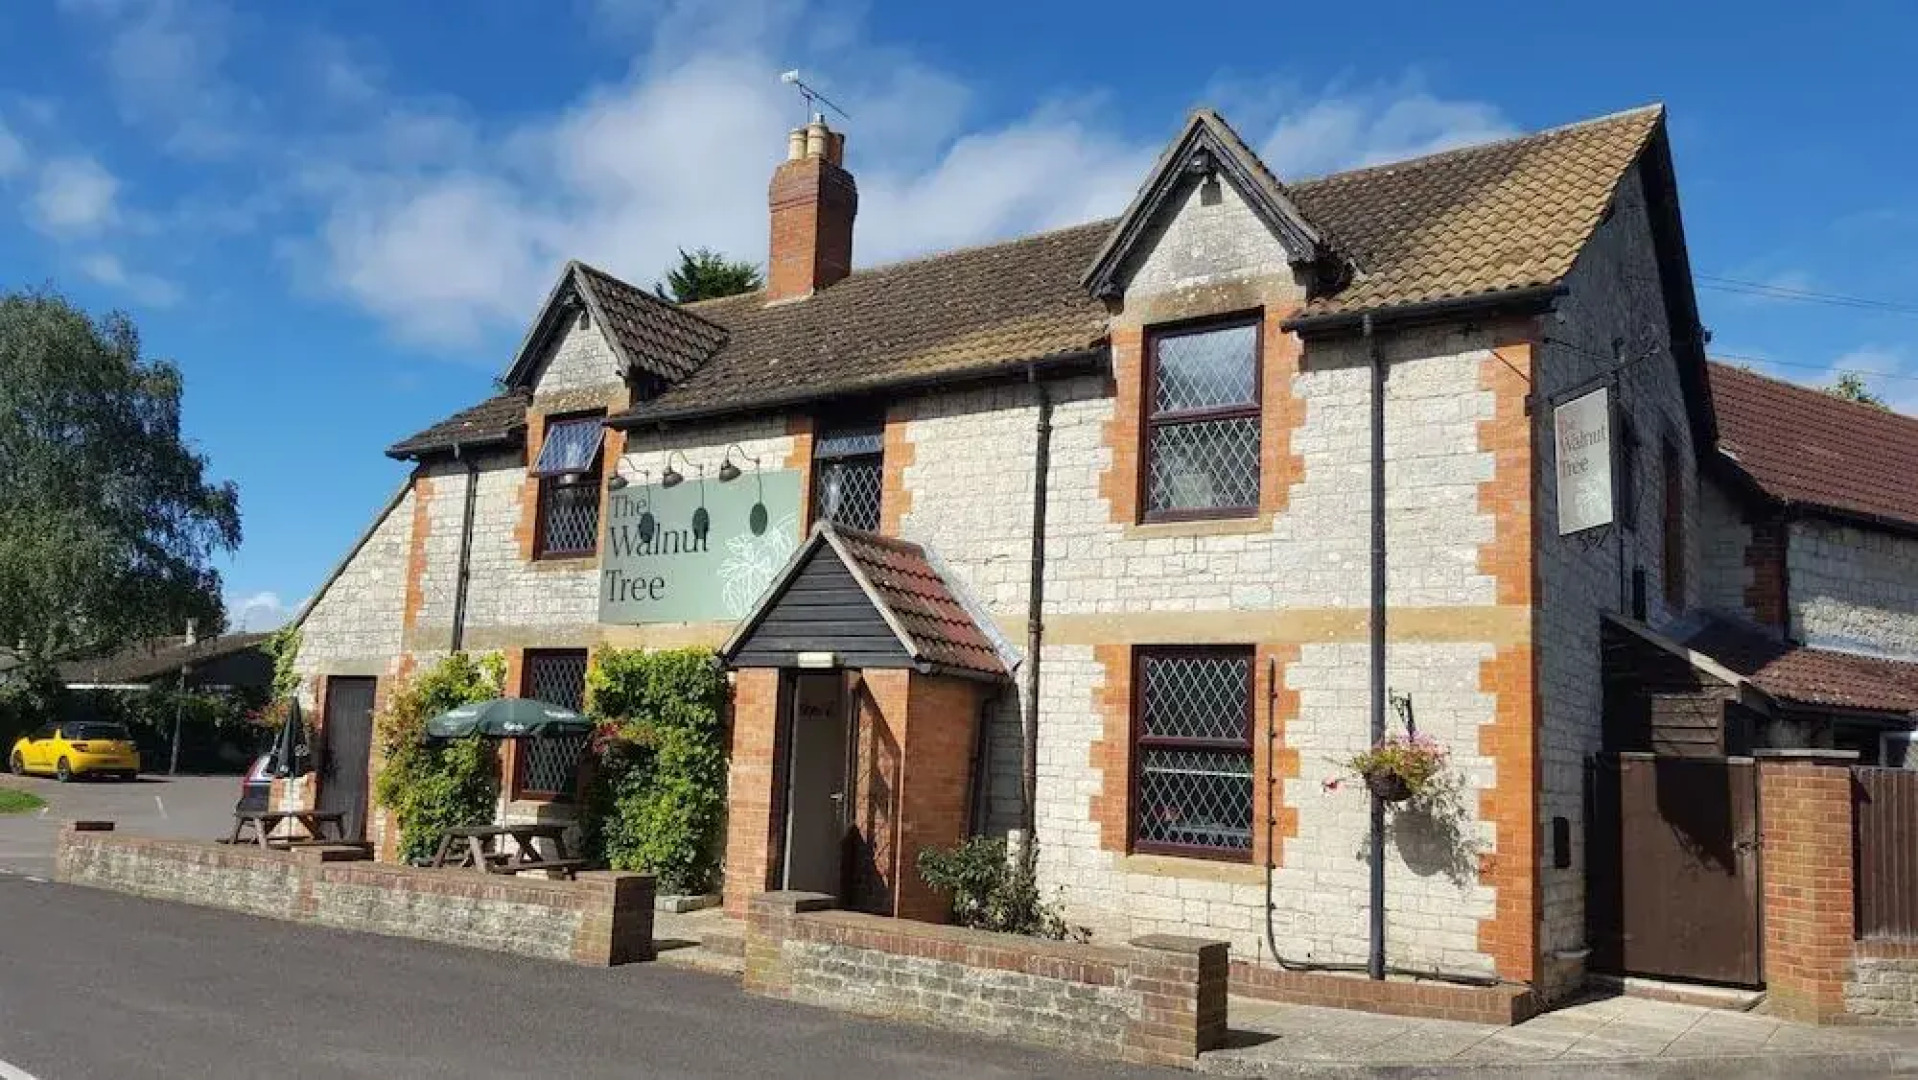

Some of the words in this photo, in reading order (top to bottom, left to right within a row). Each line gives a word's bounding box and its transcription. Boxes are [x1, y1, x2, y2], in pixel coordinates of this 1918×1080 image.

[1560, 426, 1607, 455] Walnut
[1560, 457, 1589, 478] Tree
[611, 495, 646, 518] The
[610, 522, 710, 558] Walnut
[606, 569, 665, 602] Tree
